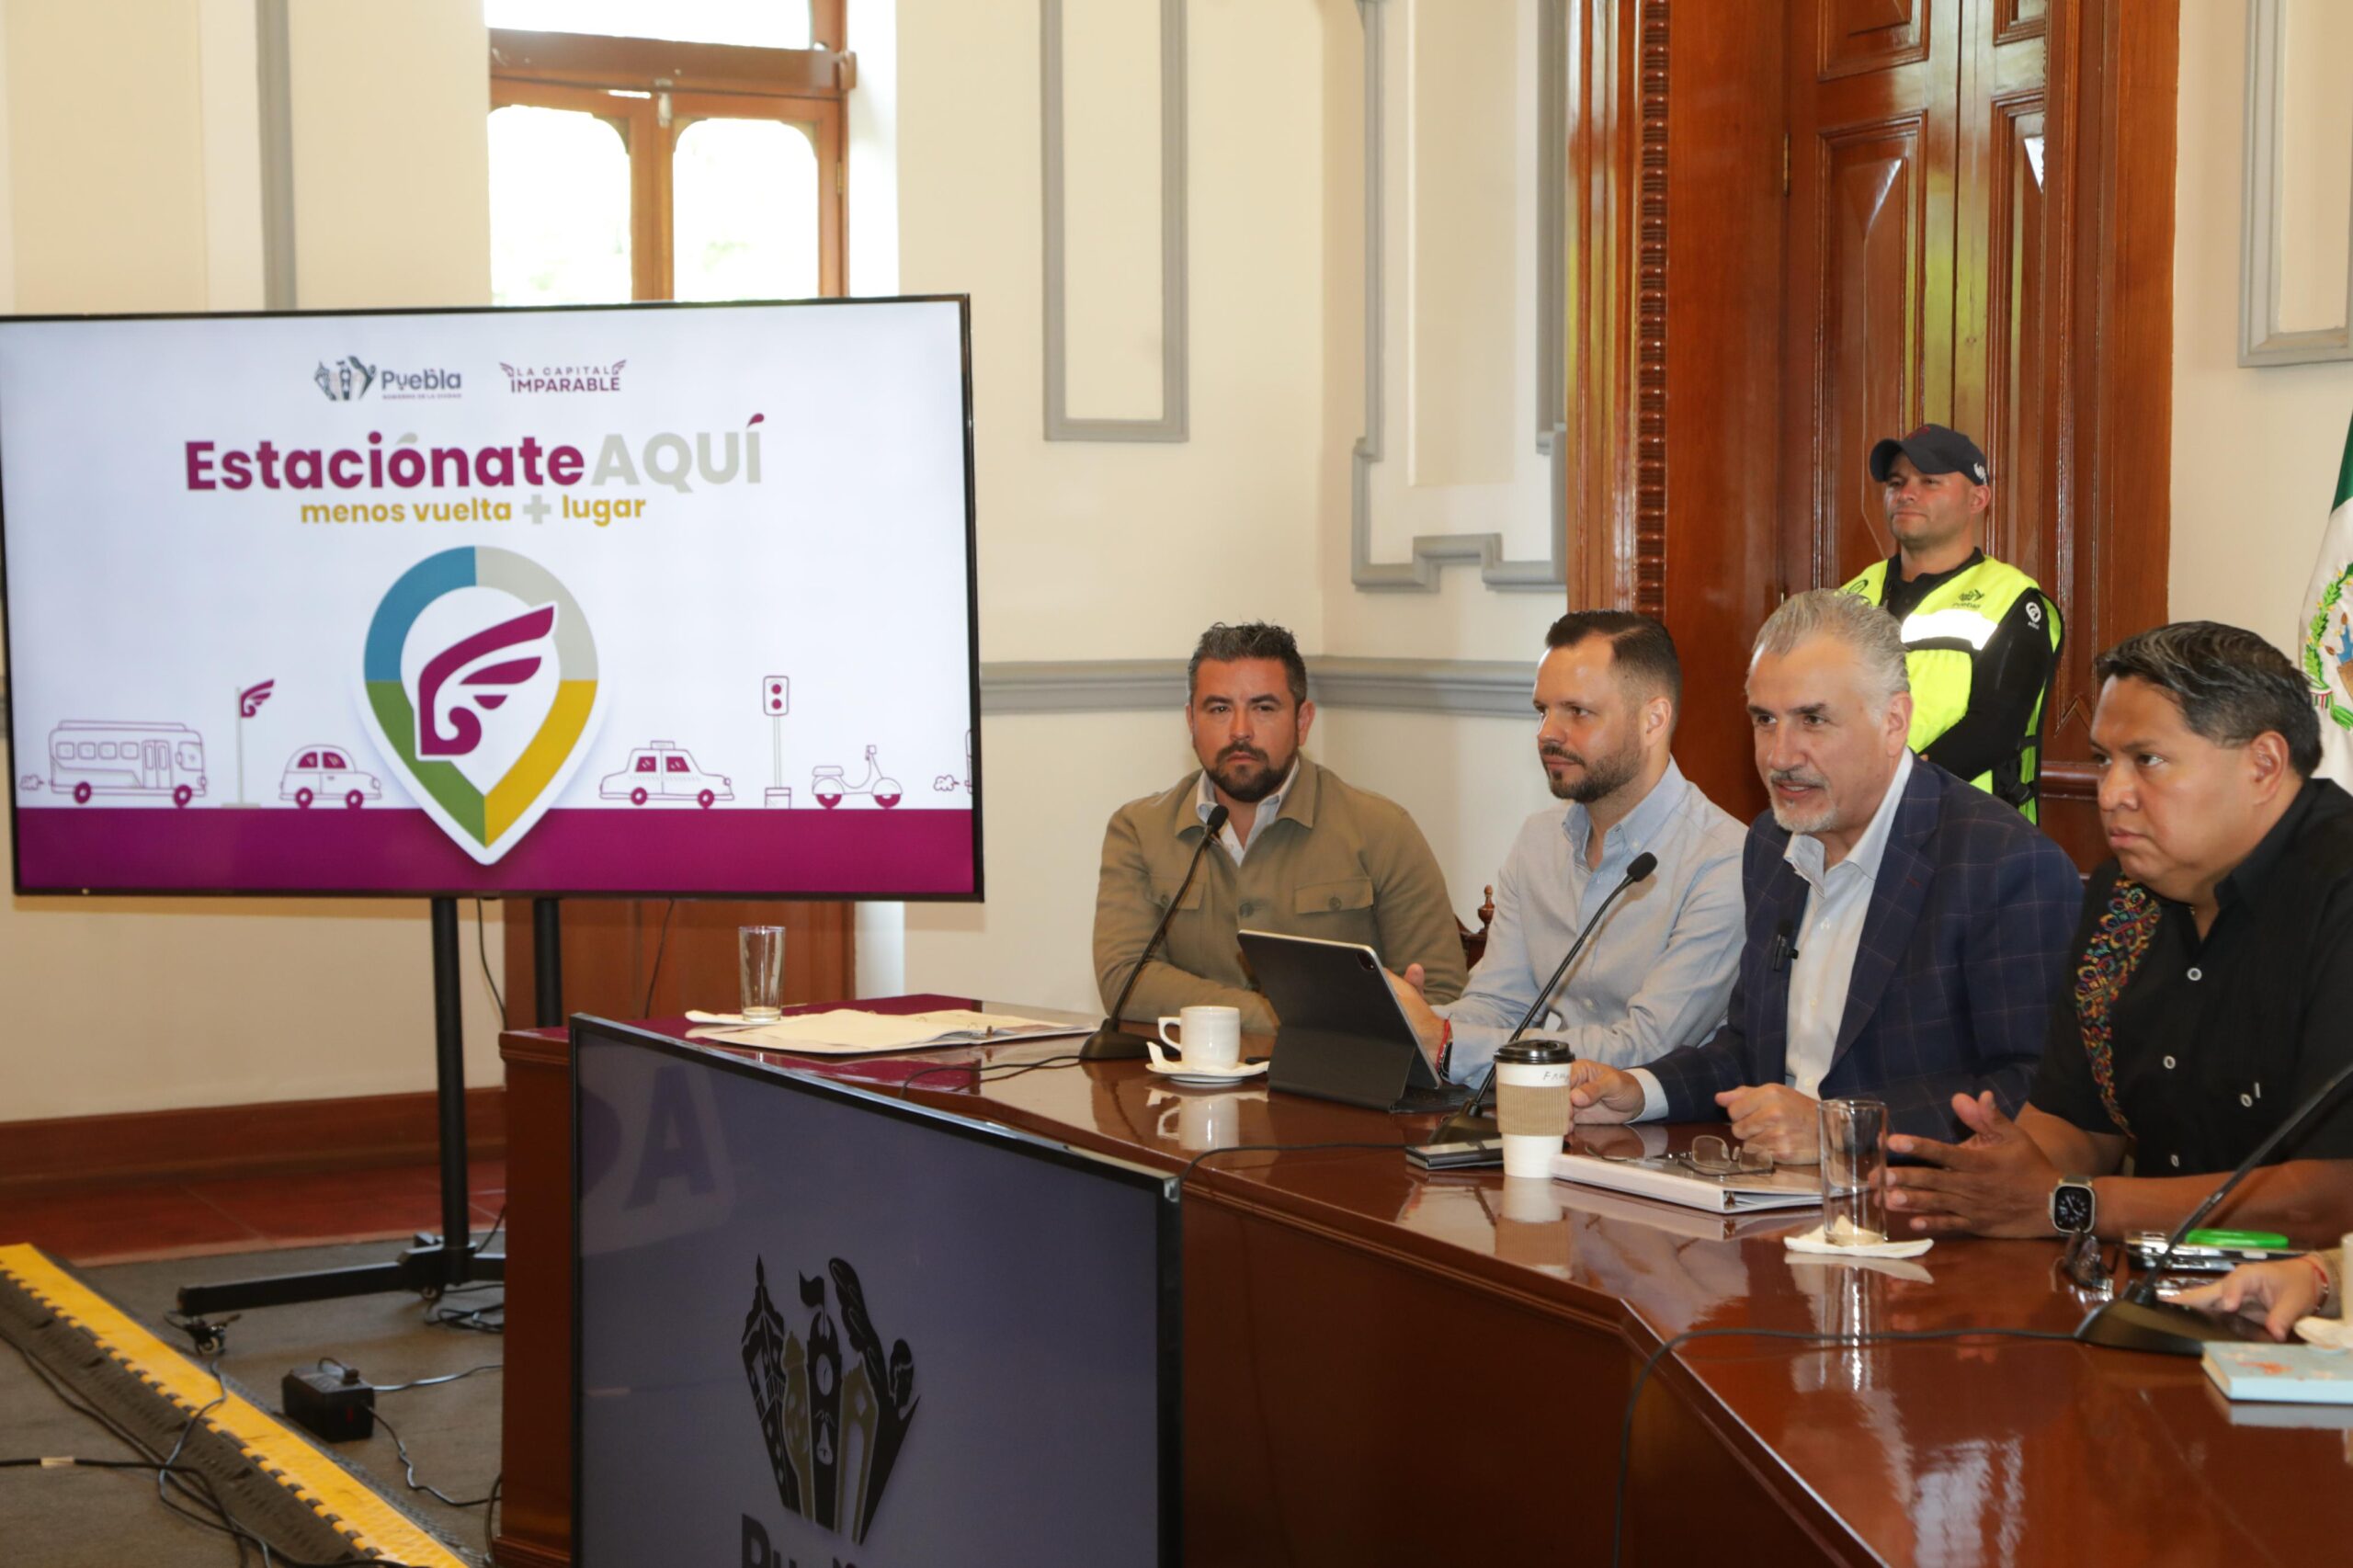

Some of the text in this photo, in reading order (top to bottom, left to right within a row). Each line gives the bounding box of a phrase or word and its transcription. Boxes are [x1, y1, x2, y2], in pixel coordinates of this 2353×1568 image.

[381, 369, 461, 391] Puebla
[517, 366, 609, 377] LA CAPITAL
[511, 377, 620, 393] IMPARABLE
[185, 413, 765, 493] Estaciónate AQUÍ
[300, 503, 406, 524] menos
[412, 496, 512, 524] vuelta
[562, 494, 647, 528] lugar
